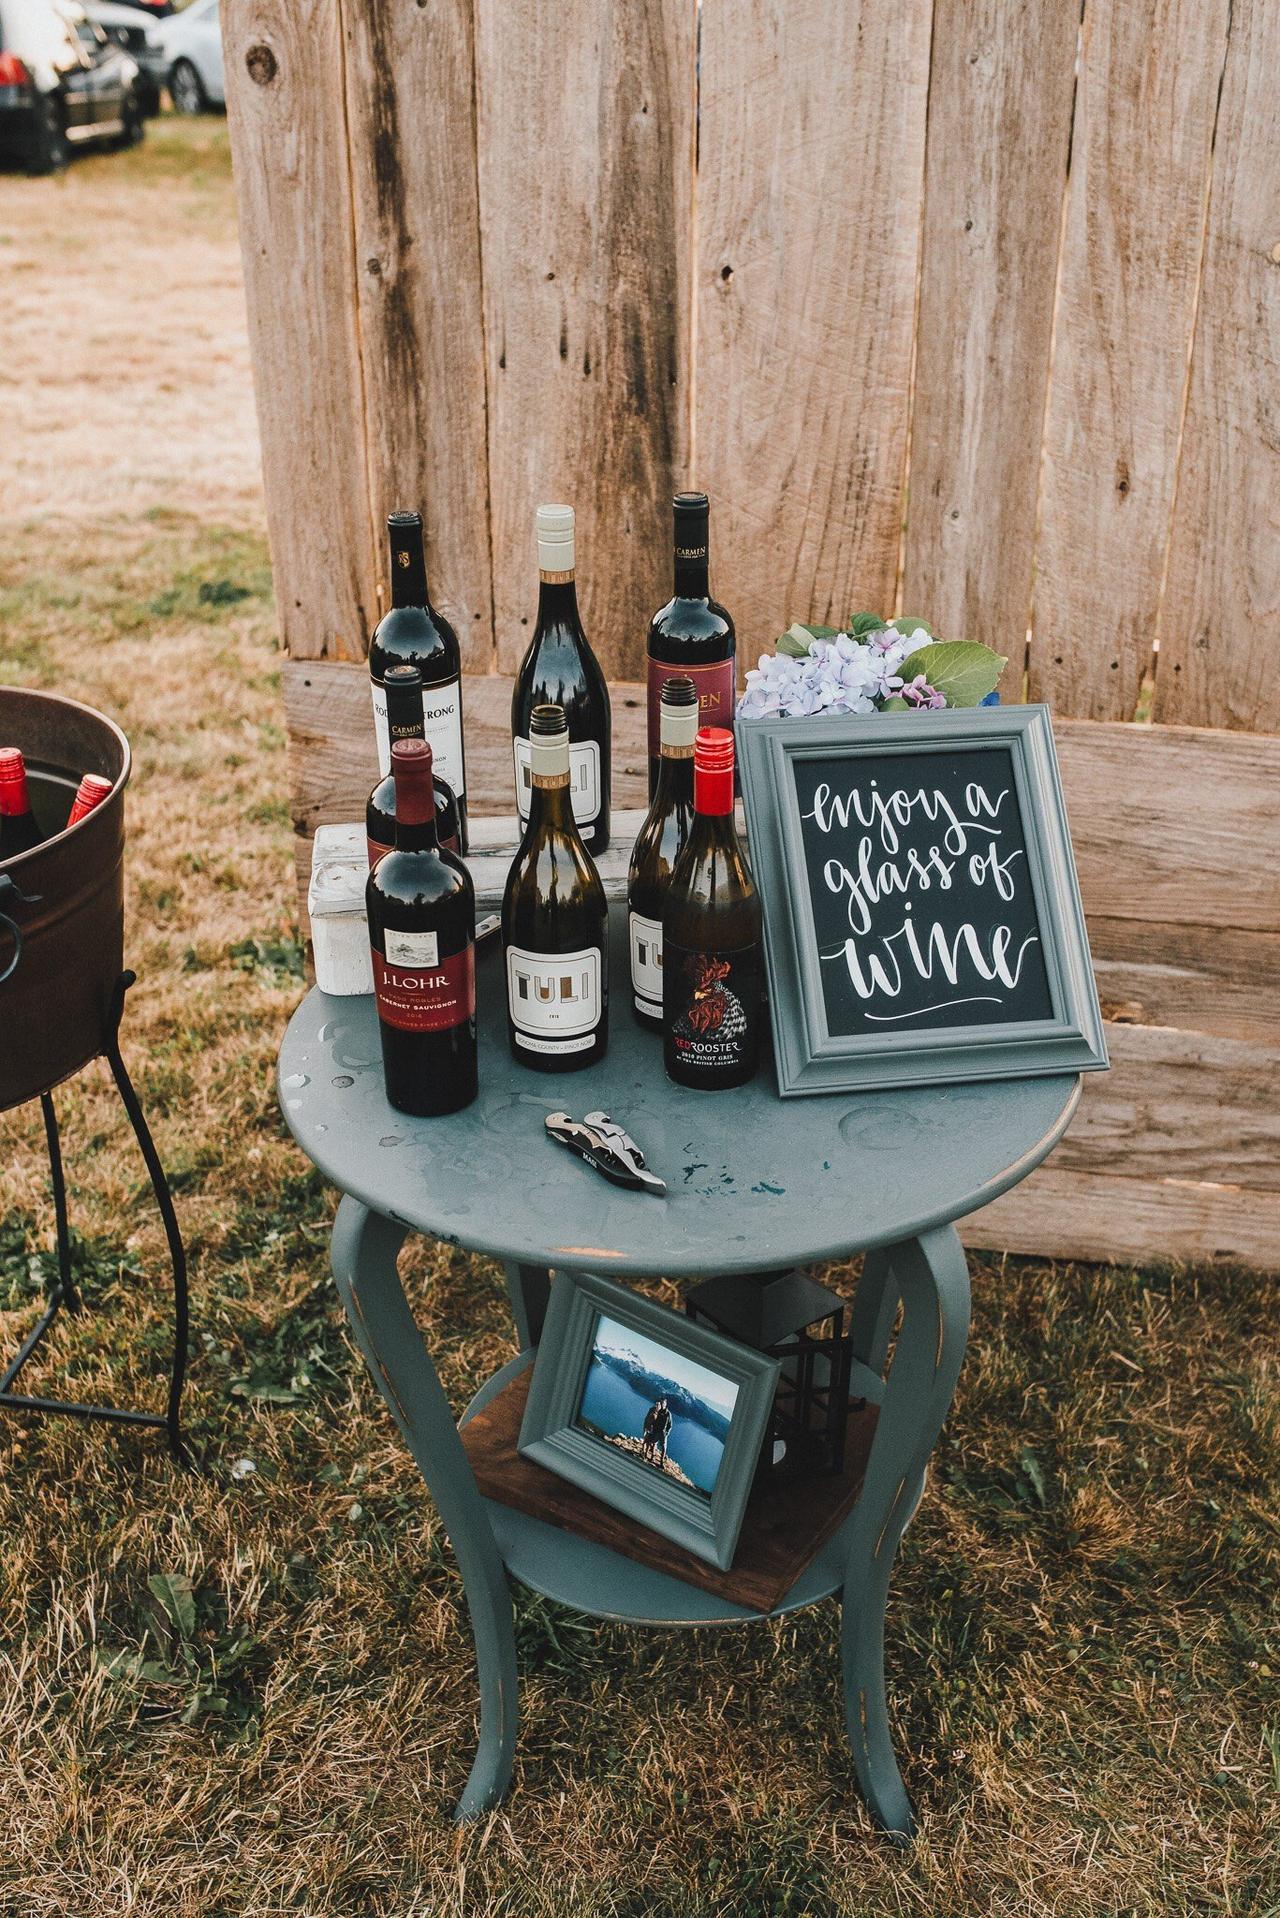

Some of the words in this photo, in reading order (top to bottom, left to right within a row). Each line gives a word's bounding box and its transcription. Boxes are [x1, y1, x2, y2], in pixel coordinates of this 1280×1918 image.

[676, 546, 706, 555] CARMEN
[391, 724, 422, 734] CARMEN
[801, 779, 1001, 856] enjoy
[965, 782, 1009, 818] a
[823, 837, 956, 935] glass
[968, 841, 1023, 901] of
[820, 901, 1038, 999] wine
[383, 971, 450, 989] J.LOHR
[515, 969, 589, 1004] TULI
[379, 994, 411, 1010] CABERNET
[413, 999, 457, 1011] SAUVIGNON
[537, 1042, 560, 1050] COUNTY
[564, 1041, 580, 1050] PINOT
[673, 1036, 742, 1054] REDROOSTER
